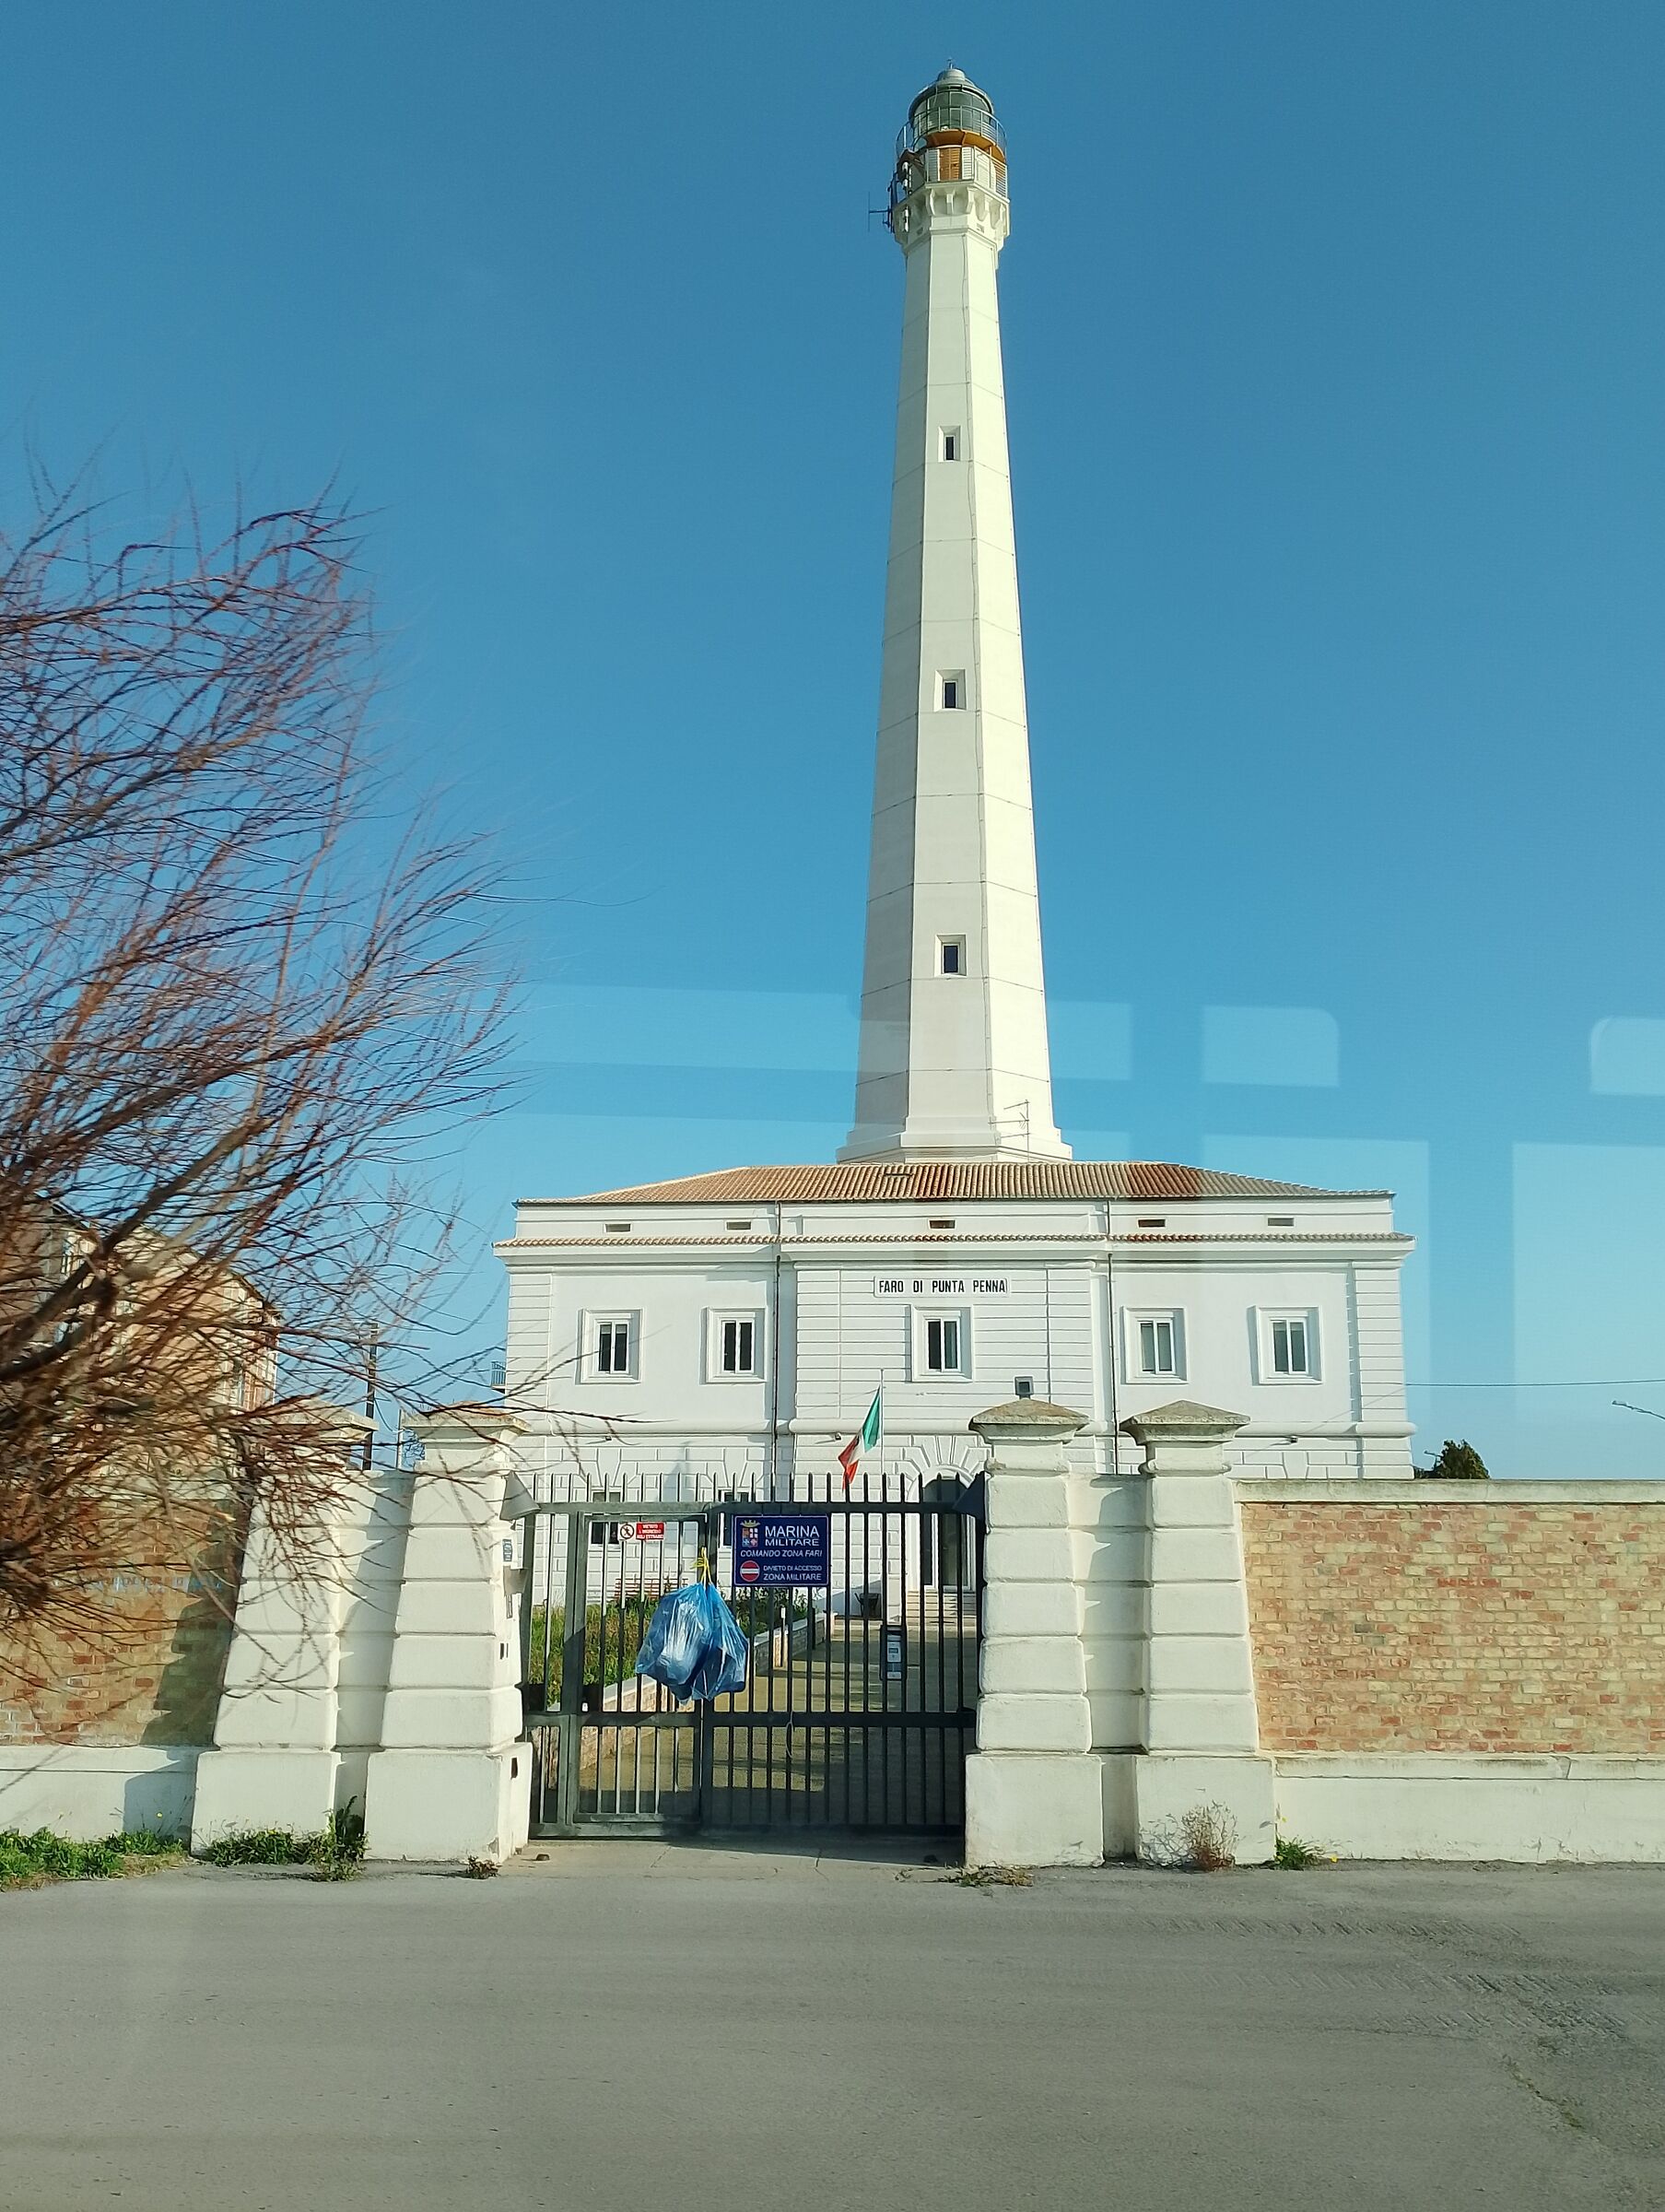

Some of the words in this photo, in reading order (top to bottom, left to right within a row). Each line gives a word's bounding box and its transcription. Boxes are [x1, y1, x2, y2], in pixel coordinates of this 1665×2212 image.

[879, 1280, 904, 1293] FARO
[913, 1280, 922, 1293] DI
[932, 1280, 965, 1293] PUNTA
[973, 1280, 1005, 1293] PENNA
[765, 1525, 820, 1537] MARINA
[765, 1538, 819, 1547] MILITARE
[740, 1549, 780, 1558] COMANDO
[781, 1549, 803, 1558] ZONA
[804, 1549, 823, 1558] FARI
